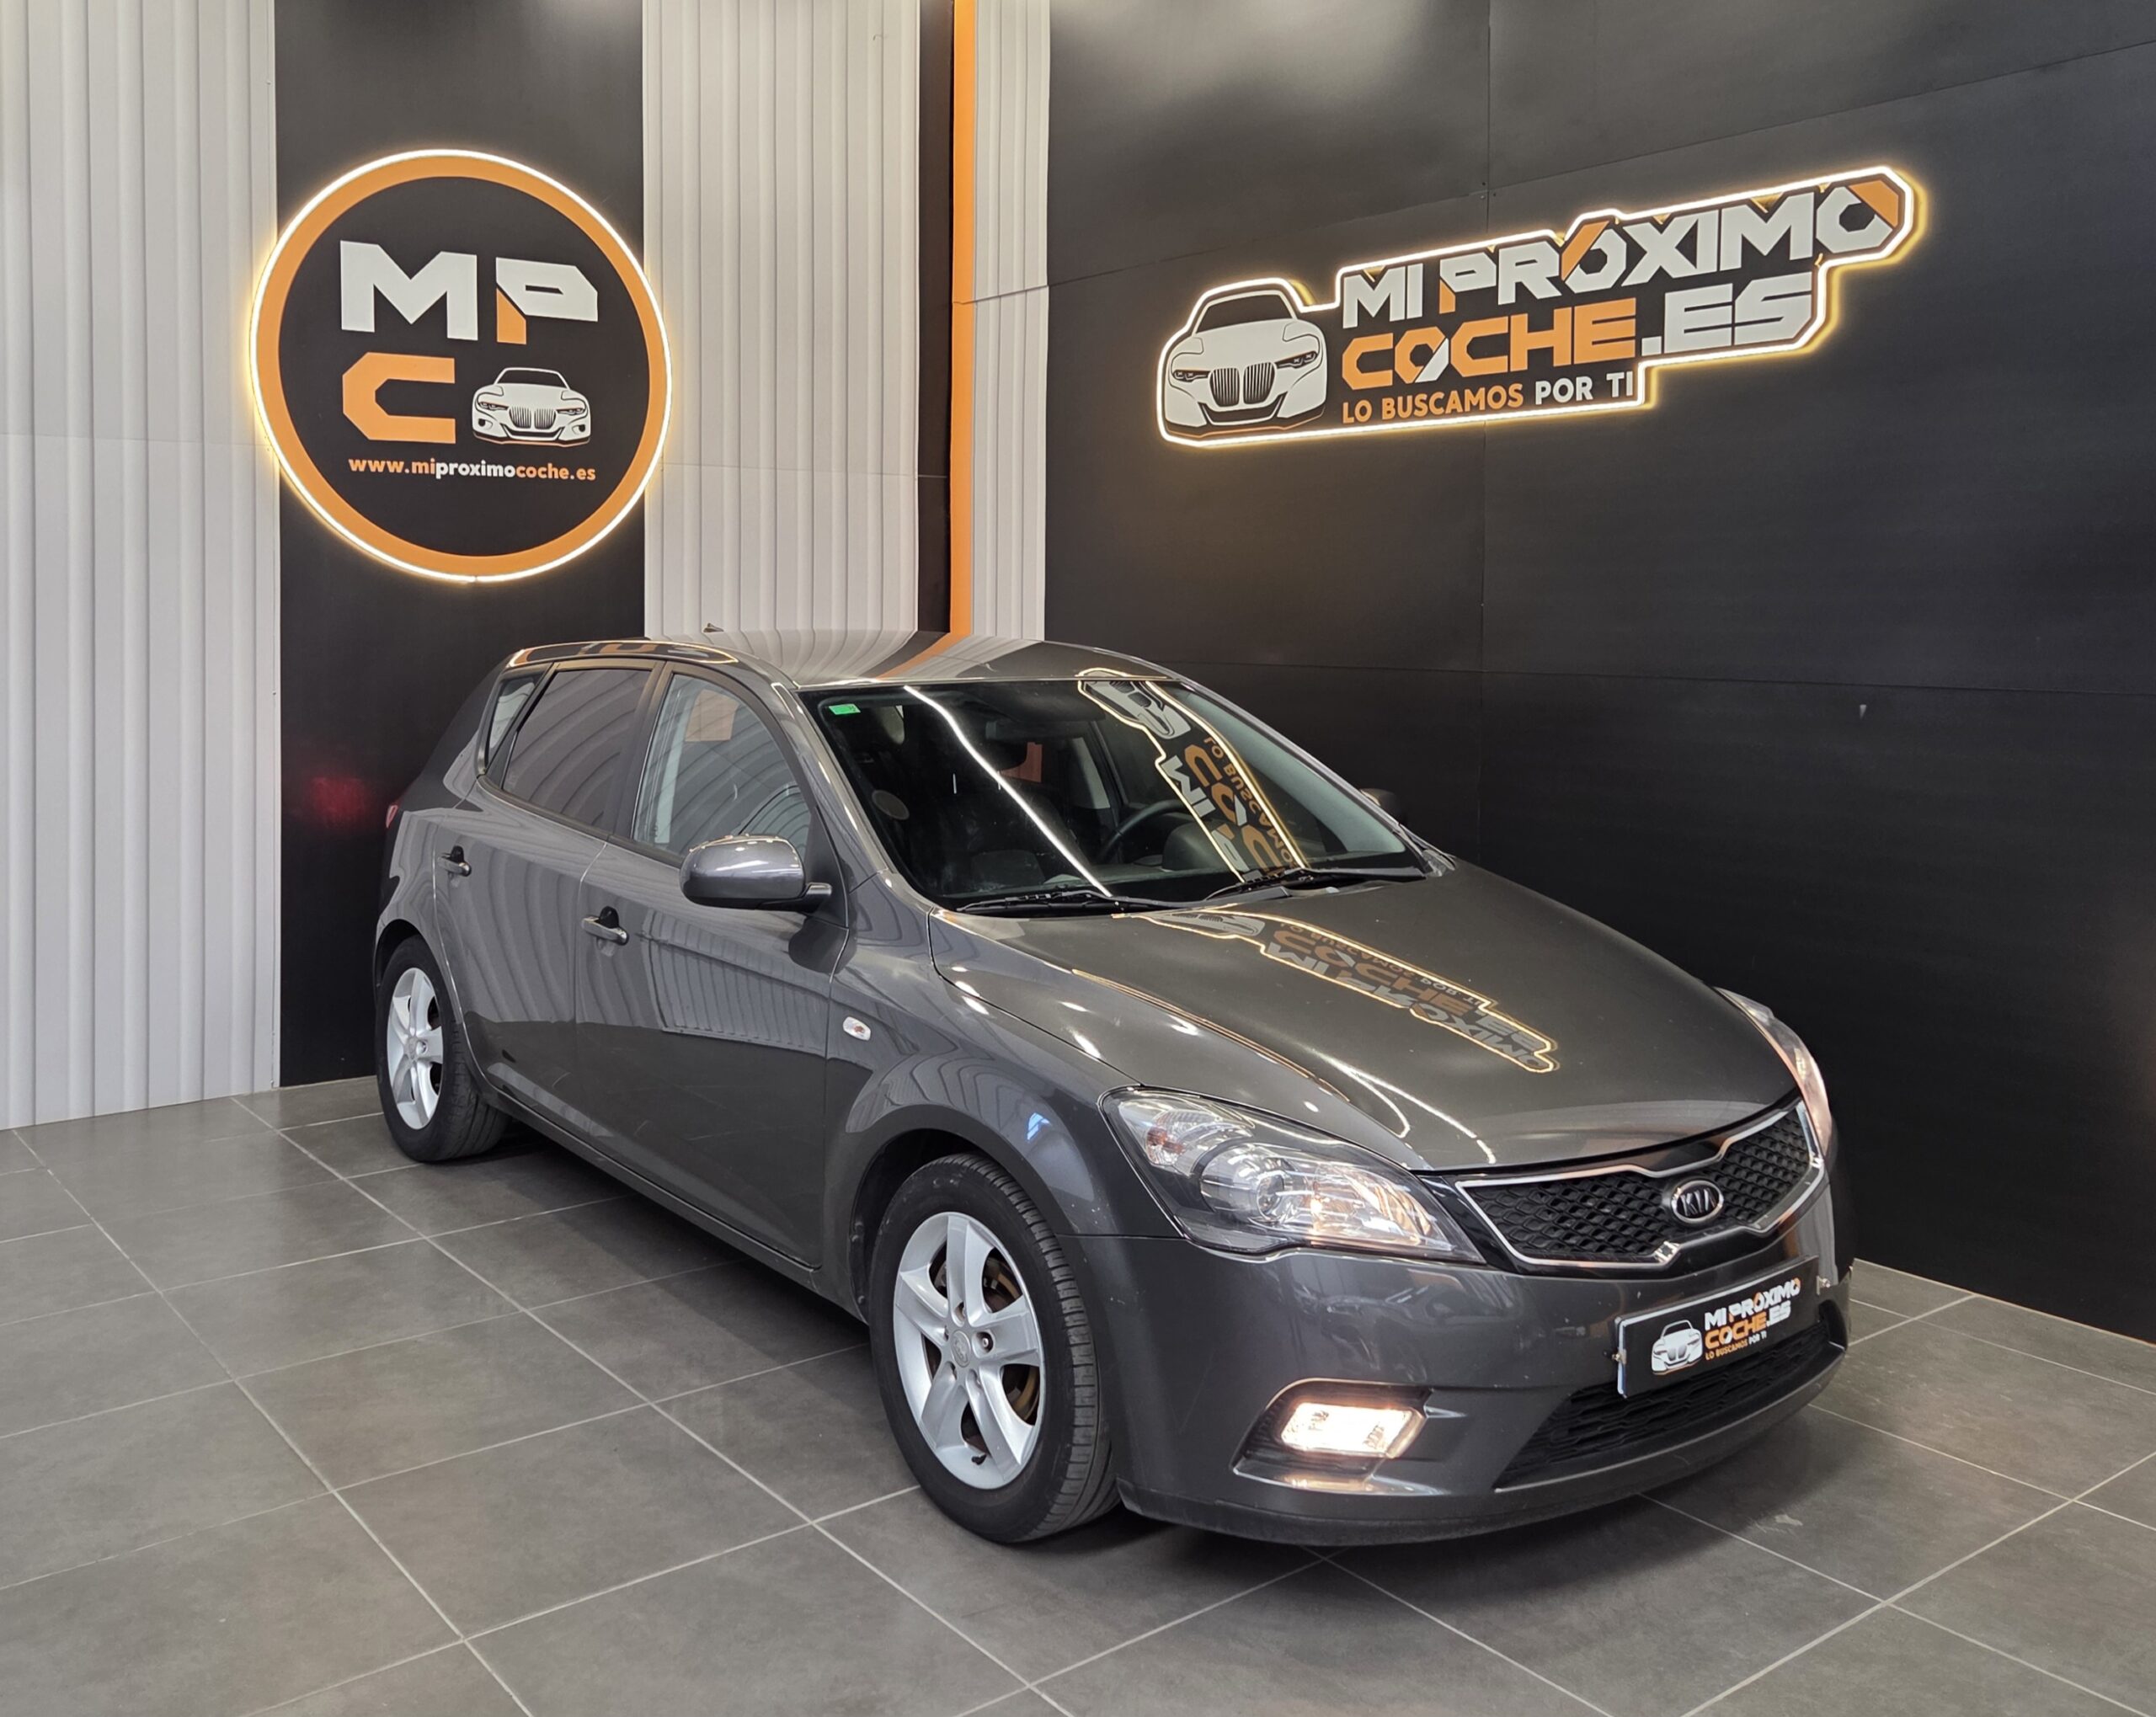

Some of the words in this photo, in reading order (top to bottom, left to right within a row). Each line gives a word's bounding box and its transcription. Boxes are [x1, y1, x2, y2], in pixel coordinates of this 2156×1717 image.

[1342, 263, 1423, 329] MI
[1342, 271, 1812, 390] COCHE.ES
[1342, 399, 1373, 424] LO
[1381, 382, 1524, 420] BUSCAMOS
[1535, 376, 1593, 405] POR
[1606, 371, 1634, 397] TI
[348, 457, 596, 481] www.miproximocoche.es
[1679, 1187, 1716, 1217] KIA
[1704, 1307, 1726, 1331] MI
